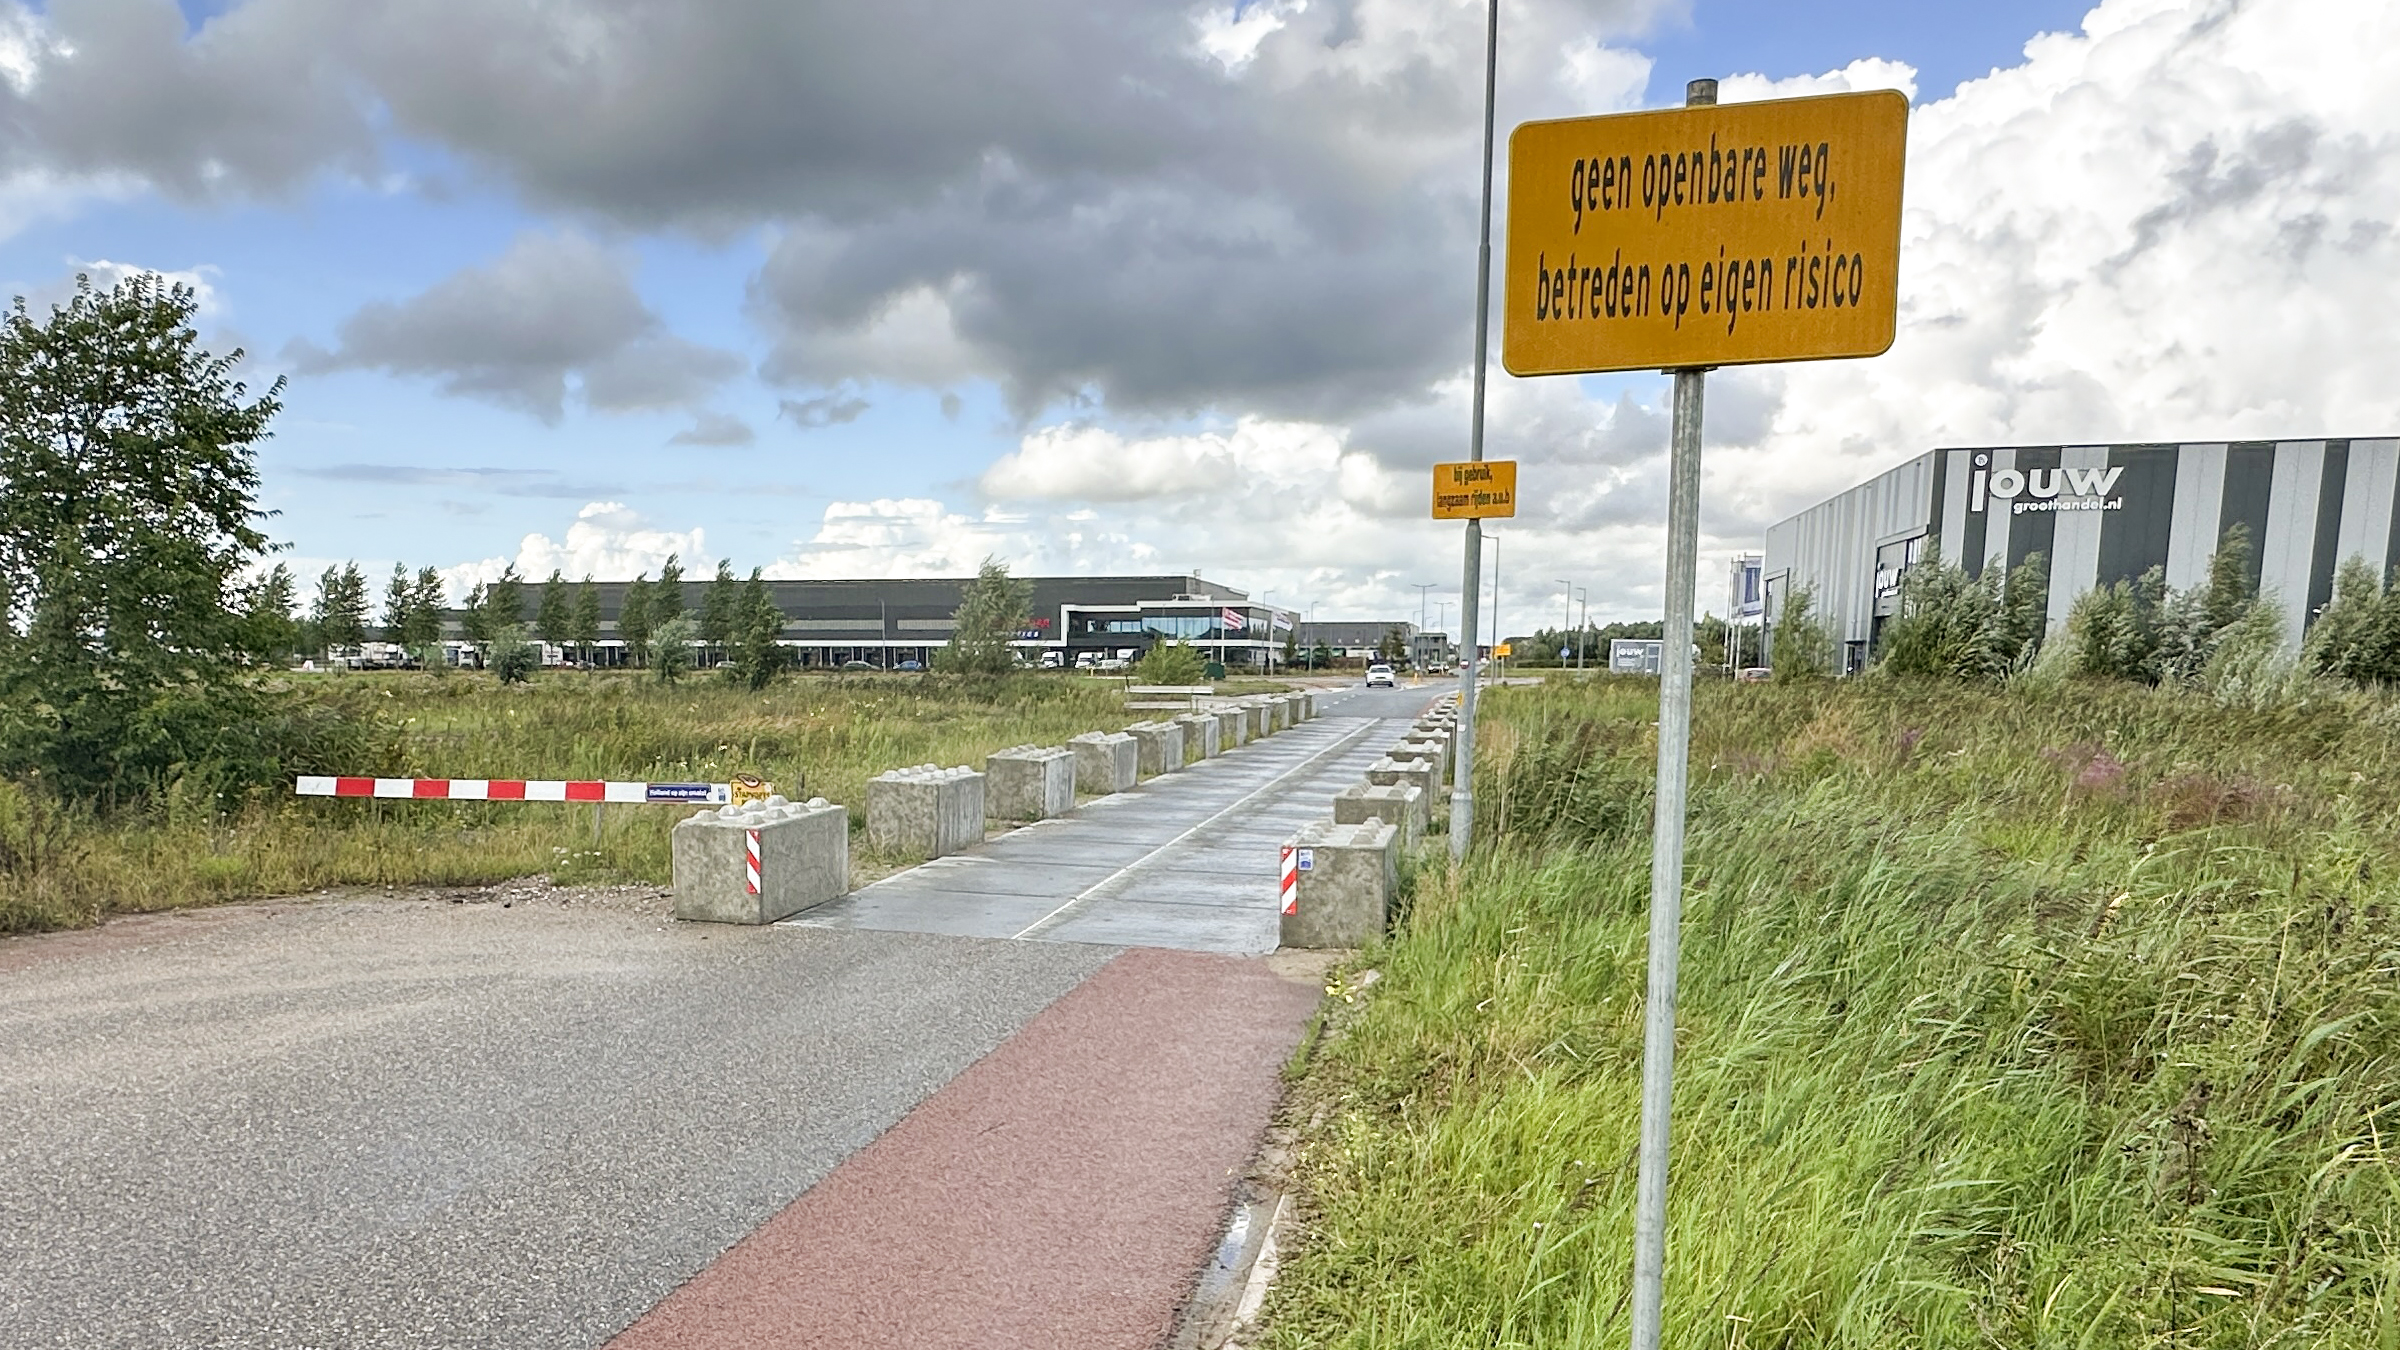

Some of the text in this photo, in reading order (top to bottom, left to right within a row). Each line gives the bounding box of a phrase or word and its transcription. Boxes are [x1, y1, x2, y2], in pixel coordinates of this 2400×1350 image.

[1571, 132, 1835, 235] geen openbare weg,
[1537, 238, 1863, 337] betreden op eigen risico
[1454, 464, 1493, 486] bij gebruik,
[1971, 453, 2124, 512] jouw
[1437, 492, 1469, 512] langzaam
[1471, 489, 1491, 510] rijden
[2013, 497, 2122, 514] groothandel.nl
[1875, 562, 1899, 599] jouw
[1616, 645, 1645, 657] jouw
